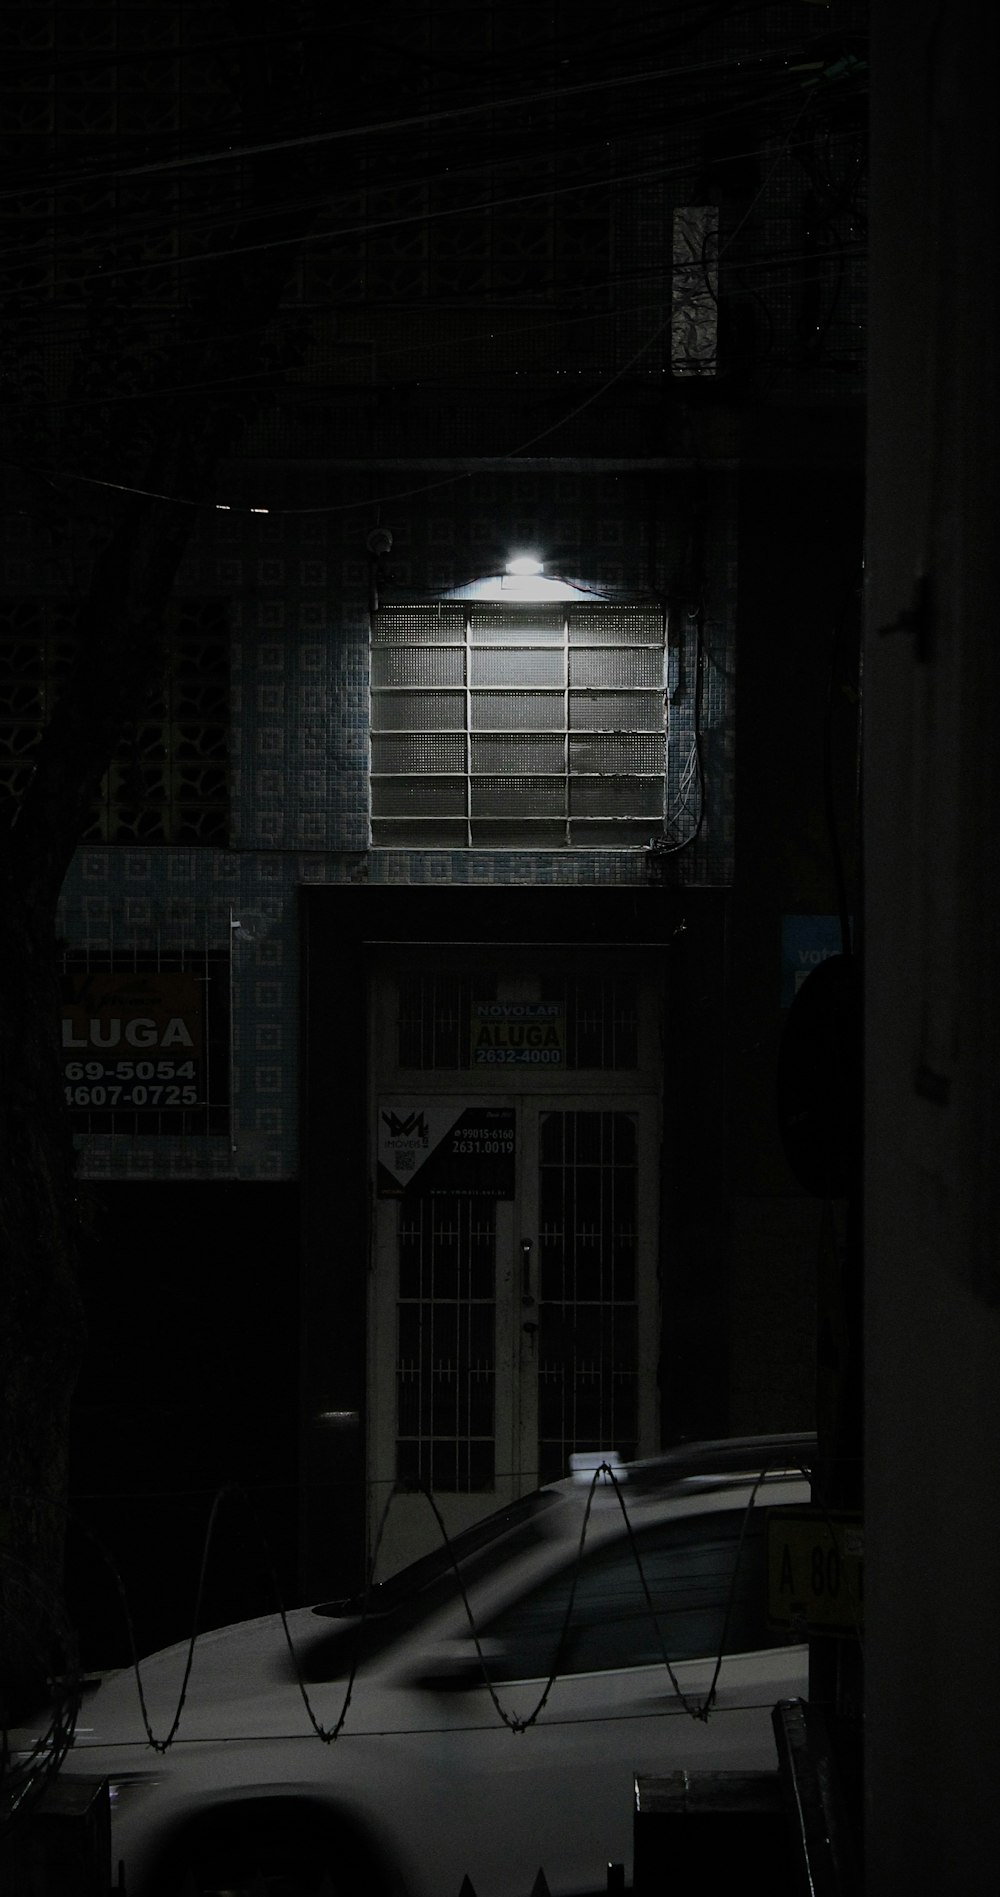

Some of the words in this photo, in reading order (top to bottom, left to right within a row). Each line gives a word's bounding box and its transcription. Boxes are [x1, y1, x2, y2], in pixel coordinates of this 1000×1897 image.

[477, 1006, 559, 1016] NOVOLAR
[61, 1017, 194, 1048] LUGA
[476, 1025, 560, 1047] ALUGA
[476, 1049, 561, 1063] 2632-4000
[64, 1060, 196, 1081] 69-5054
[462, 1128, 514, 1139] 99015-6160
[452, 1140, 514, 1153] 2631.0019
[779, 1543, 796, 1595] A
[810, 1544, 841, 1598] 80
